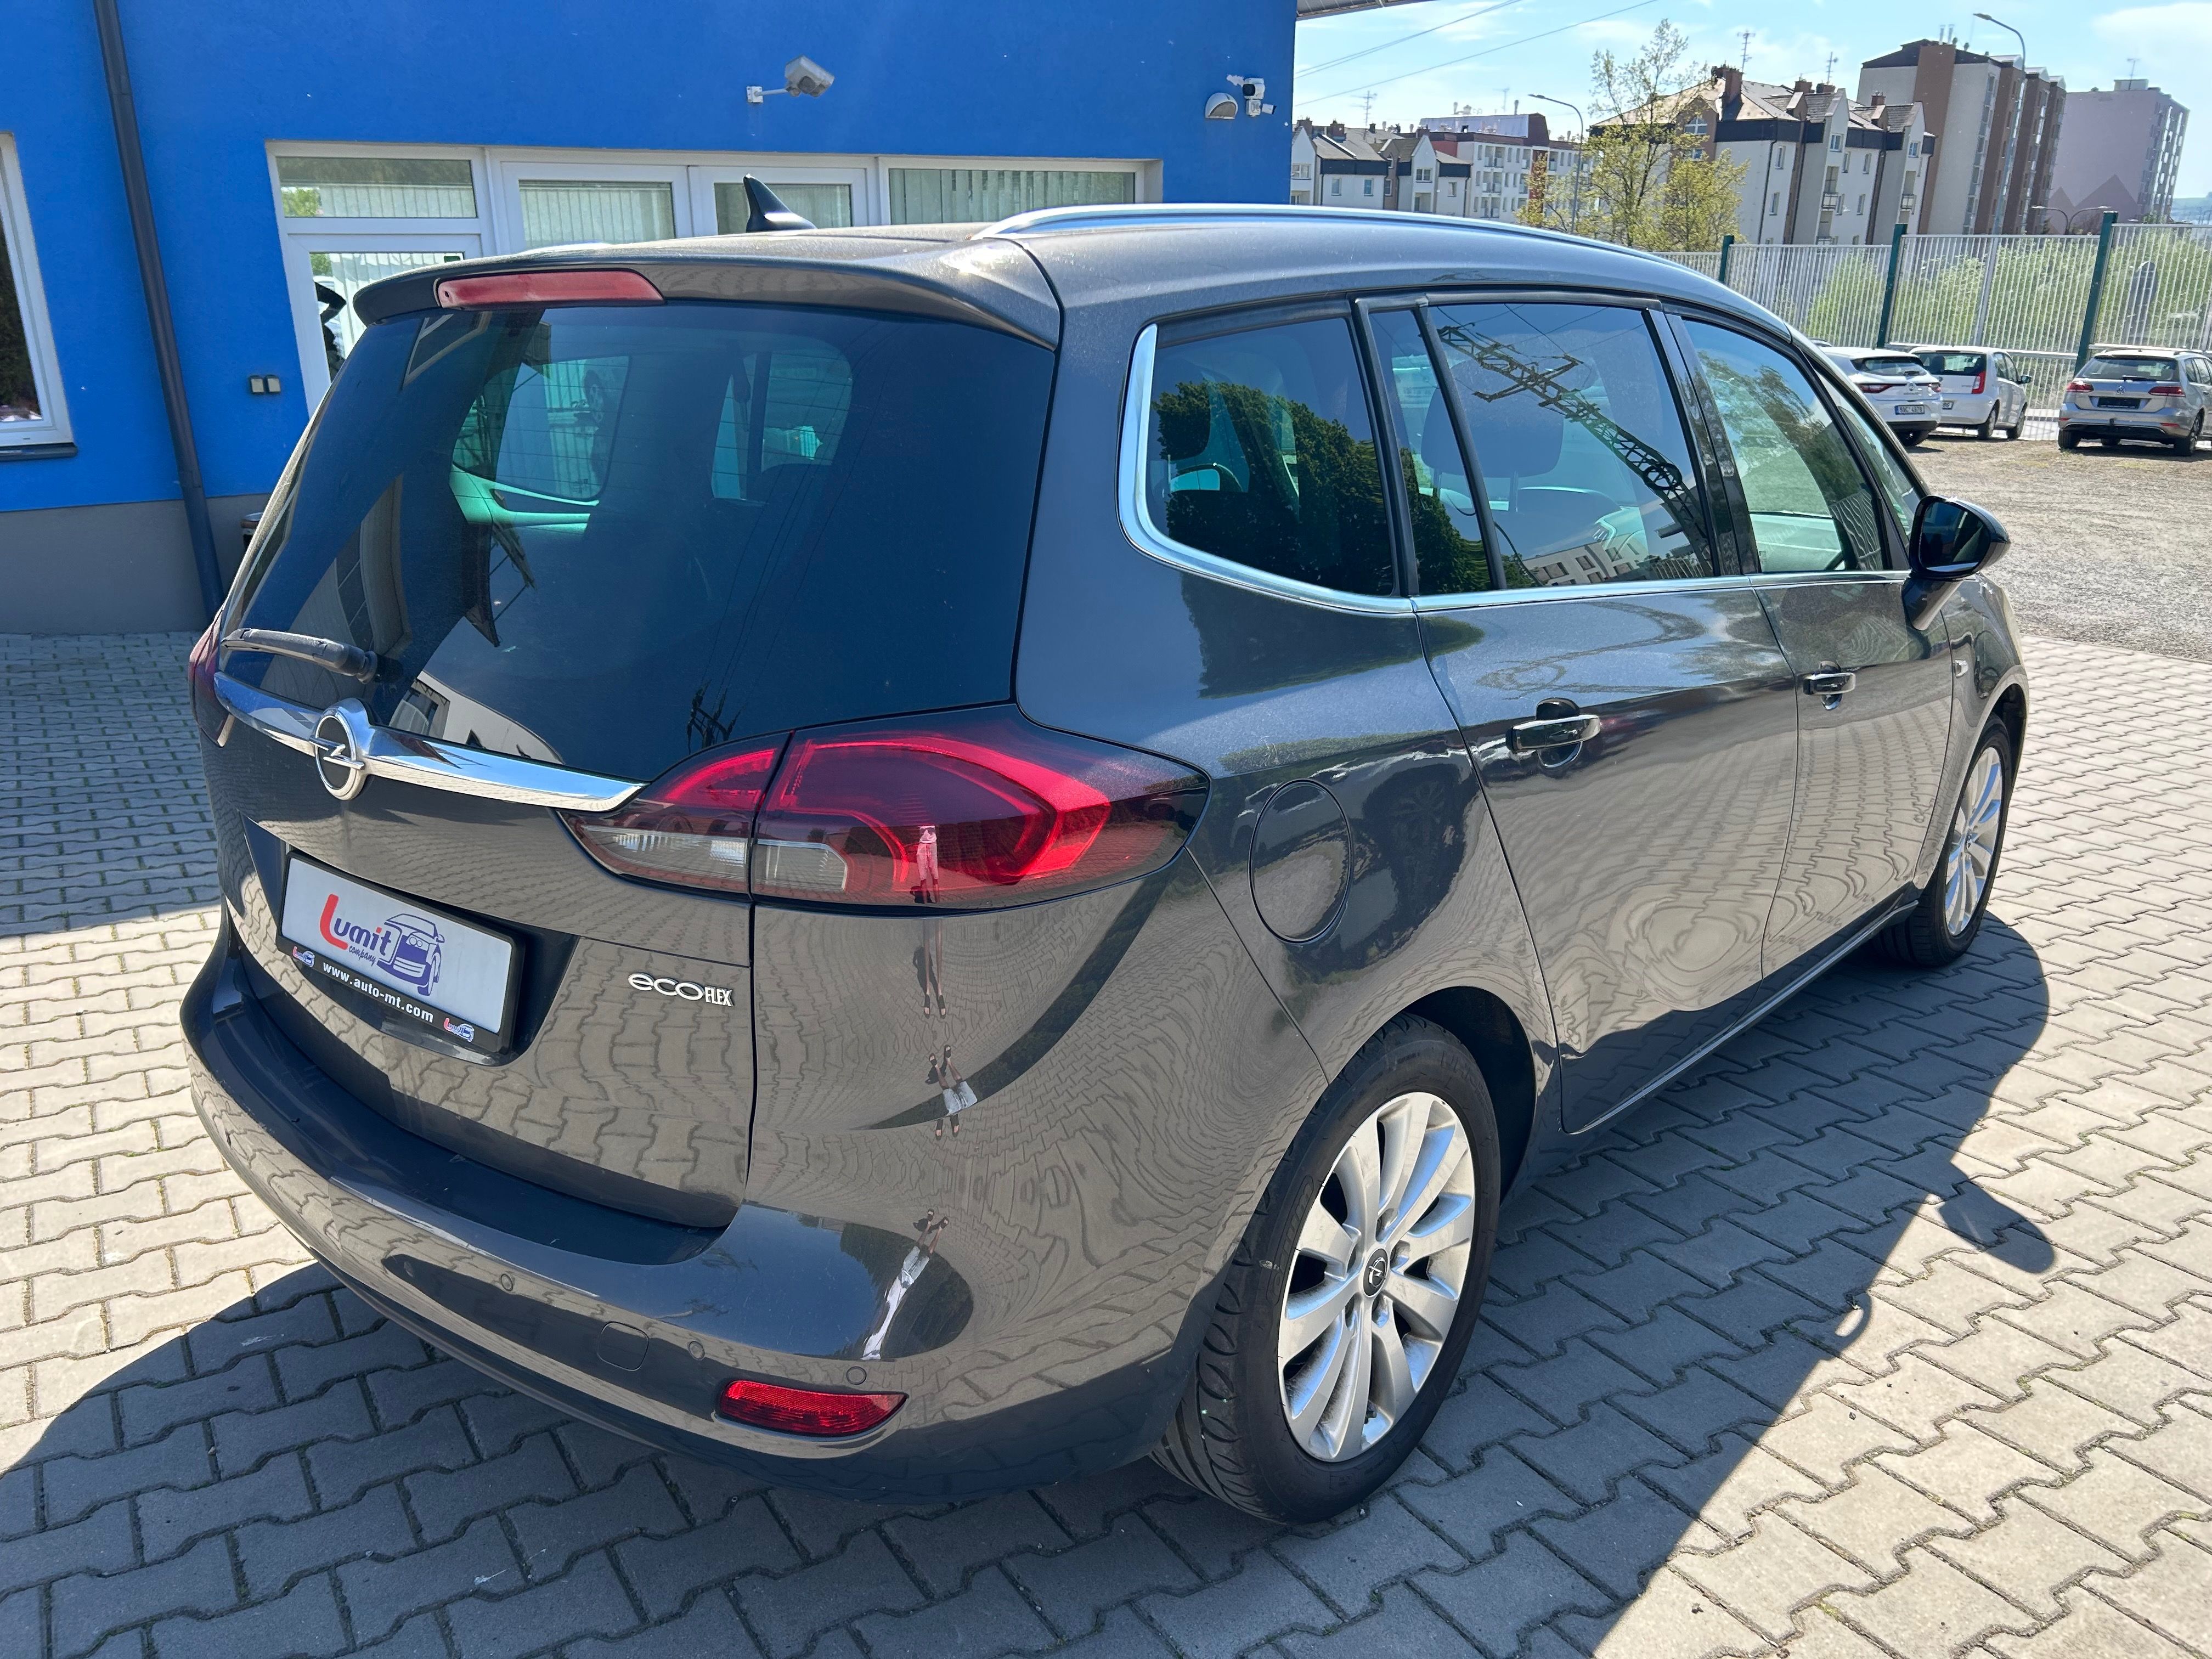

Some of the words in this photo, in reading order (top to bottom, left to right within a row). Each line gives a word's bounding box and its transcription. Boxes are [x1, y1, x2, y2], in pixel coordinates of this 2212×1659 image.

[320, 894, 391, 956] Lumit
[349, 945, 376, 967] company
[323, 962, 433, 1023] www.auto-mt.com
